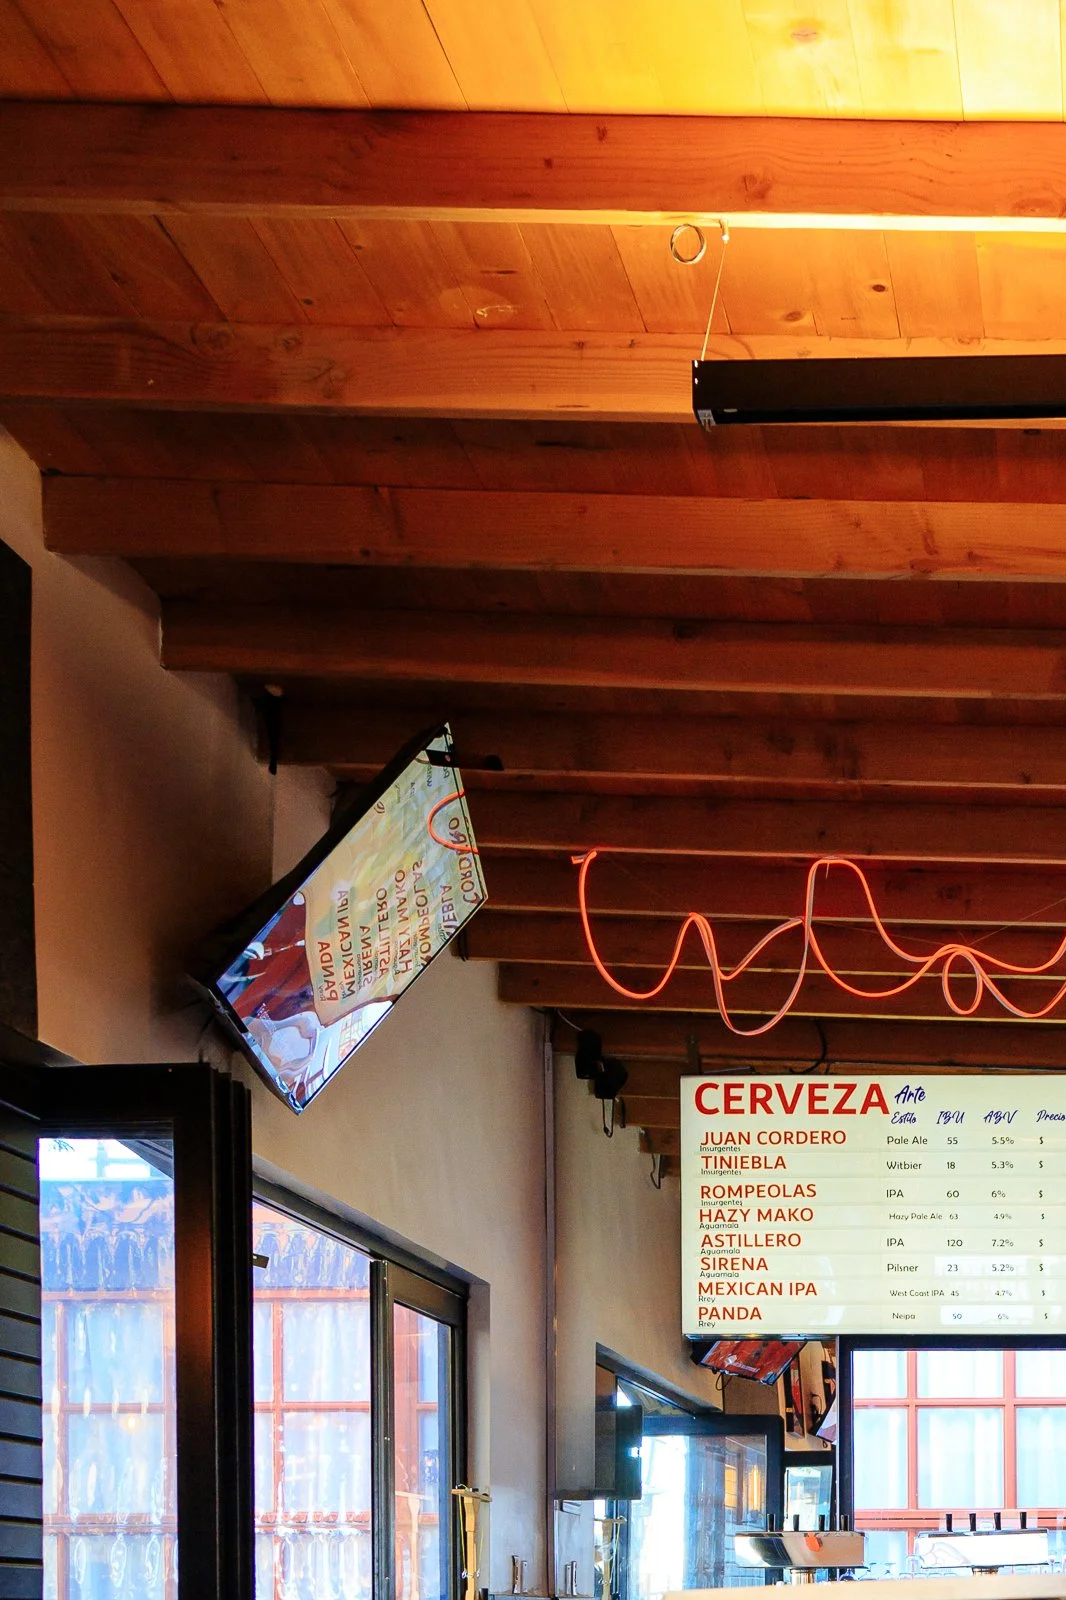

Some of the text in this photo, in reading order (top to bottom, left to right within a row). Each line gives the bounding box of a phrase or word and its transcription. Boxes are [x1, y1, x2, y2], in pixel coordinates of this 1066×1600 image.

[694, 1082, 890, 1115] CERVEZA
[894, 1085, 926, 1104] Arte
[891, 1112, 917, 1124] Estilo
[936, 1111, 965, 1124] IBU
[983, 1110, 1018, 1124] ABV
[1036, 1110, 1066, 1123] Precio
[700, 1130, 846, 1145] JUAN CORDERO
[887, 1136, 928, 1145] Pale Ale
[947, 1137, 958, 1145] 55
[992, 1137, 1014, 1145] 5.5%
[1039, 1136, 1044, 1145] $
[701, 1156, 786, 1170] TINIEBLA
[887, 1162, 922, 1170] Witbier
[947, 1162, 955, 1170] 18
[991, 1161, 1013, 1169] 5.3%
[1039, 1161, 1043, 1169] $
[701, 1168, 741, 1176] Insurgentes
[701, 1184, 817, 1199] ROMPEOLAS
[886, 1190, 904, 1198] IPA
[991, 1190, 1005, 1198] 6%
[1039, 1190, 1043, 1198] $
[699, 1208, 814, 1222] HAZY MAKO
[889, 1213, 909, 1221] Hazy
[701, 1233, 802, 1247] ASTILLERO
[887, 1238, 904, 1247] IPA
[947, 1239, 963, 1247] 120
[992, 1239, 1014, 1247] 7.2%
[1039, 1239, 1044, 1247] $
[701, 1257, 768, 1271] SIRENA
[887, 1264, 919, 1272] Pilsner
[947, 1264, 959, 1272] 23
[992, 1264, 1014, 1272] 5.2%
[698, 1282, 818, 1296] MEXICAN IPA
[698, 1306, 762, 1320] PANDA
